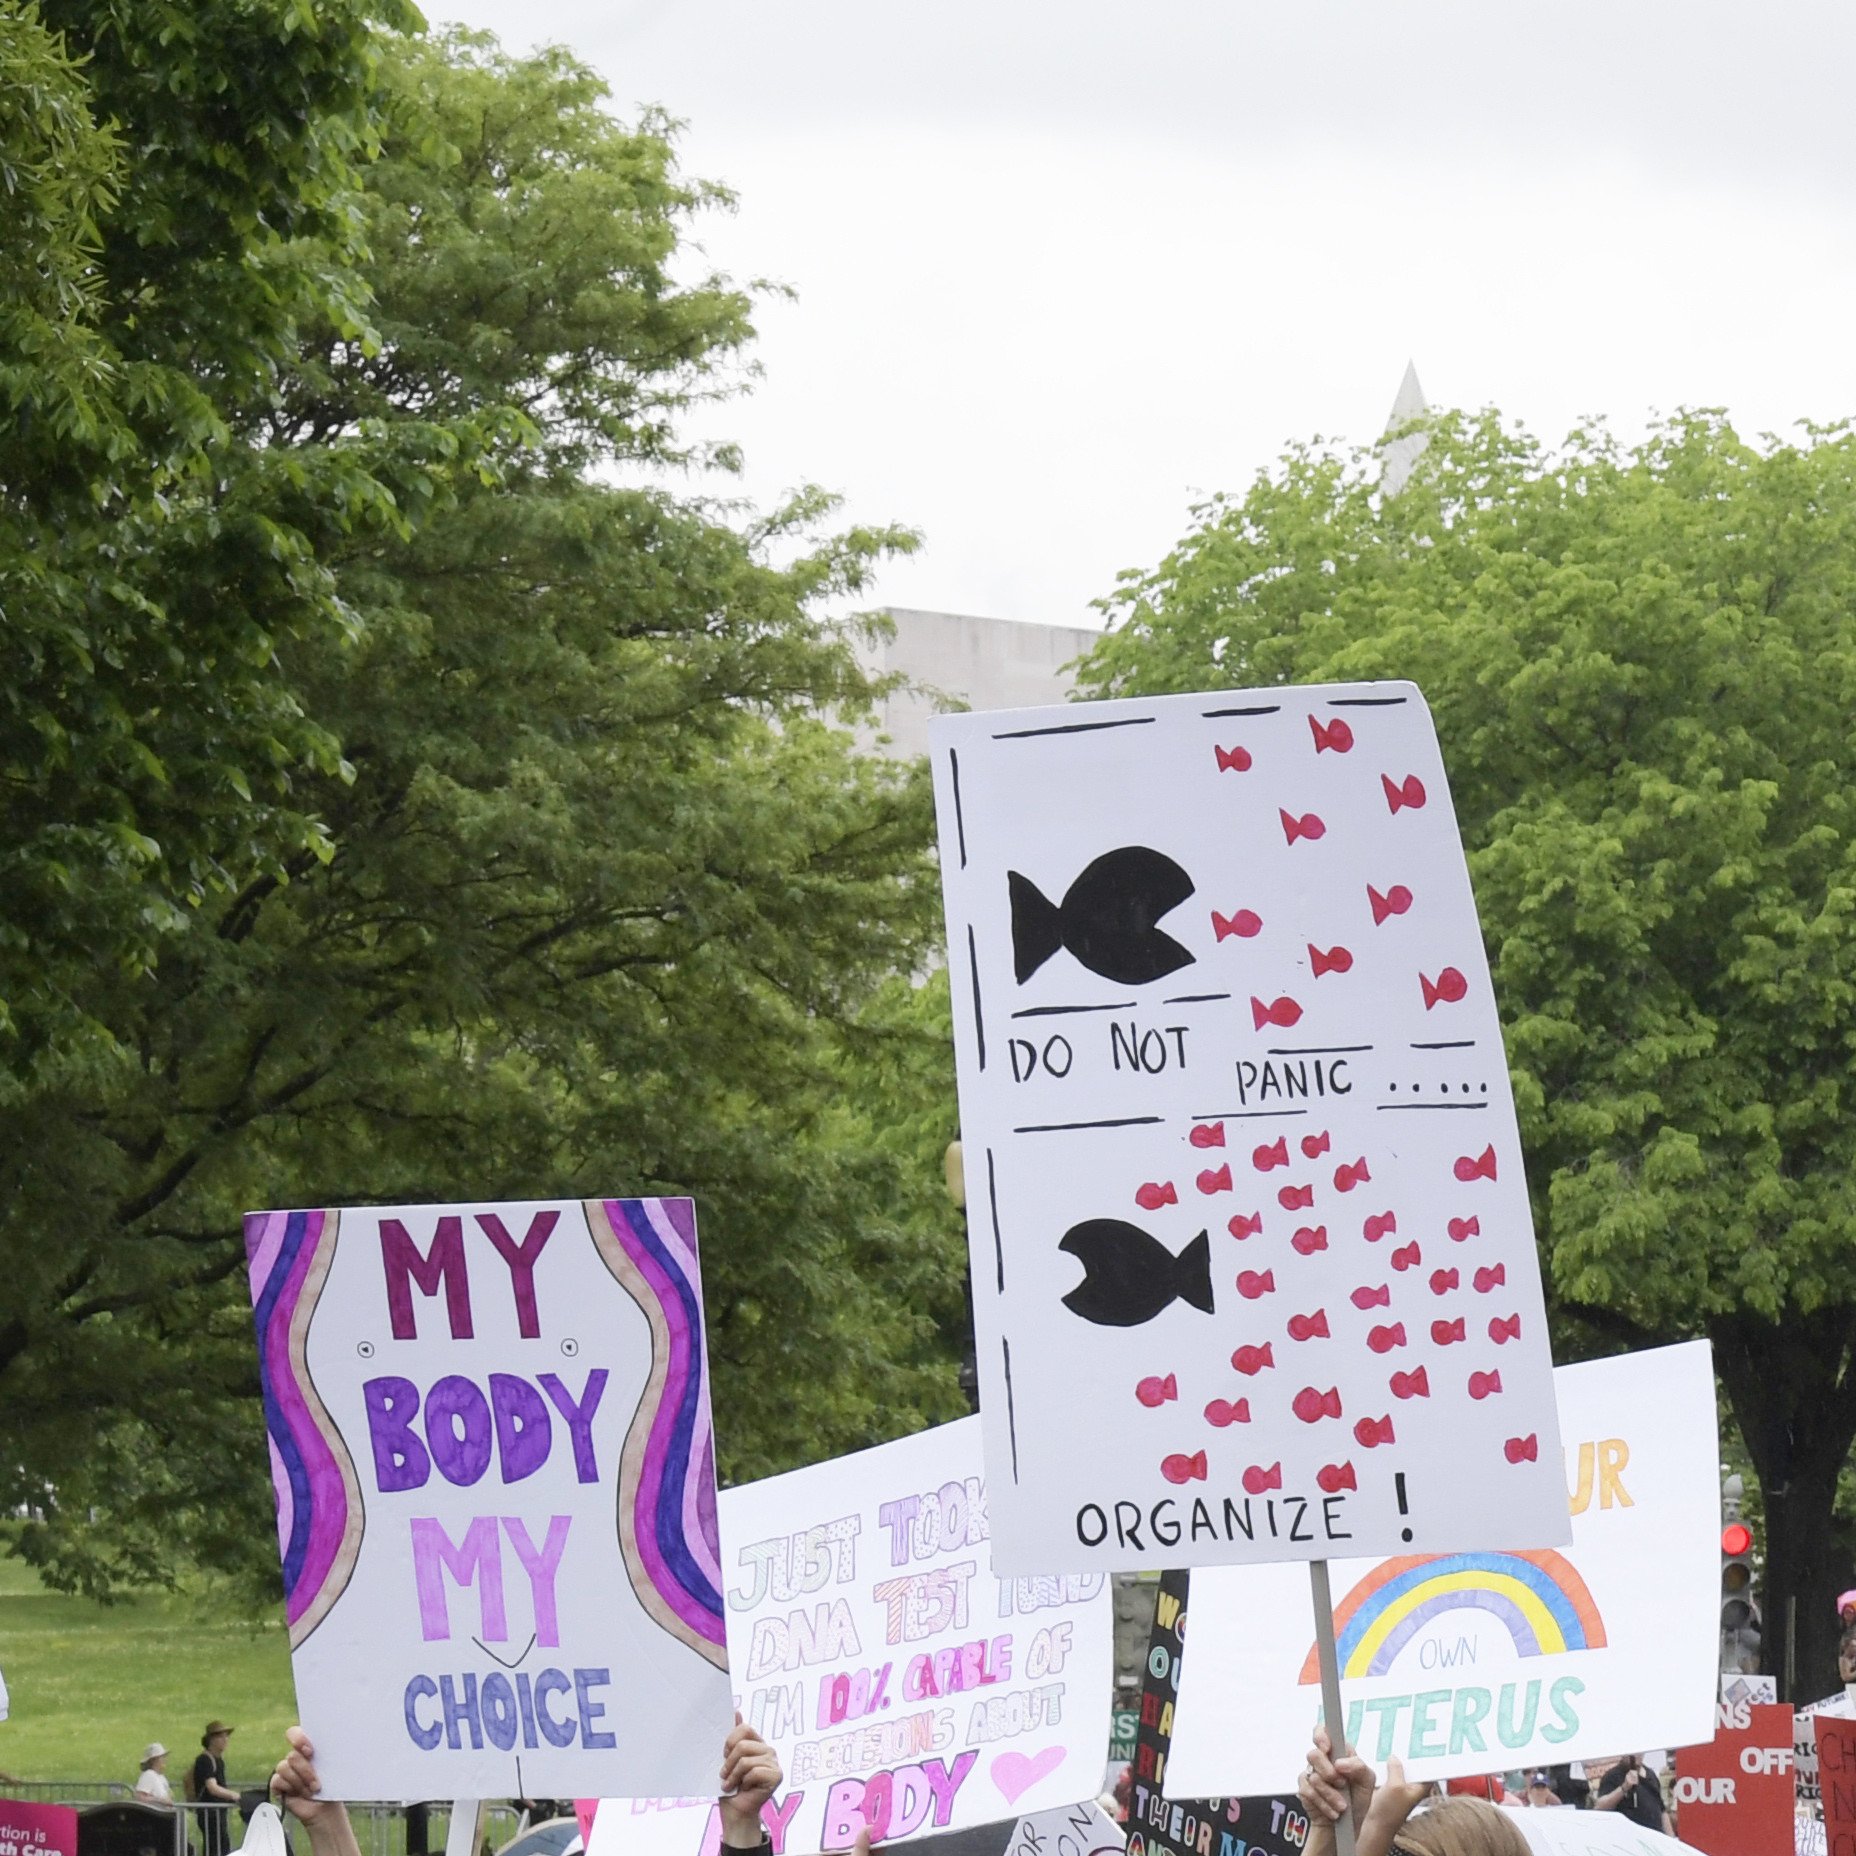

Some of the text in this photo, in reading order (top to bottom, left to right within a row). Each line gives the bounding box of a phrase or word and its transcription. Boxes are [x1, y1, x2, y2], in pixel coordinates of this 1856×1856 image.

[1008, 1021, 1190, 1083] DO NOT
[1237, 1060, 1354, 1105] PANIC
[378, 1210, 561, 1340] MY
[362, 1368, 610, 1492] BODY
[1560, 1438, 1636, 1517] UR
[1074, 1495, 1354, 1552] ORGANIZE
[409, 1516, 572, 1648] MY
[728, 1513, 862, 1612] JUST
[746, 1598, 863, 1681] DNA
[873, 1560, 977, 1645] TEST
[1420, 1633, 1478, 1670] OWN
[404, 1668, 617, 1751] CHOICE
[751, 1681, 805, 1740] I'M
[816, 1661, 893, 1731] 100%
[902, 1633, 1014, 1702] CAPABLE
[1026, 1620, 1074, 1680] OF
[965, 1682, 1066, 1746] ABOUT
[1715, 1702, 1751, 1729] NS
[1675, 1777, 1736, 1803] OUR
[1740, 1747, 1794, 1775] OFF
[34, 1828, 46, 1843] is
[820, 1749, 981, 1852] BODY
